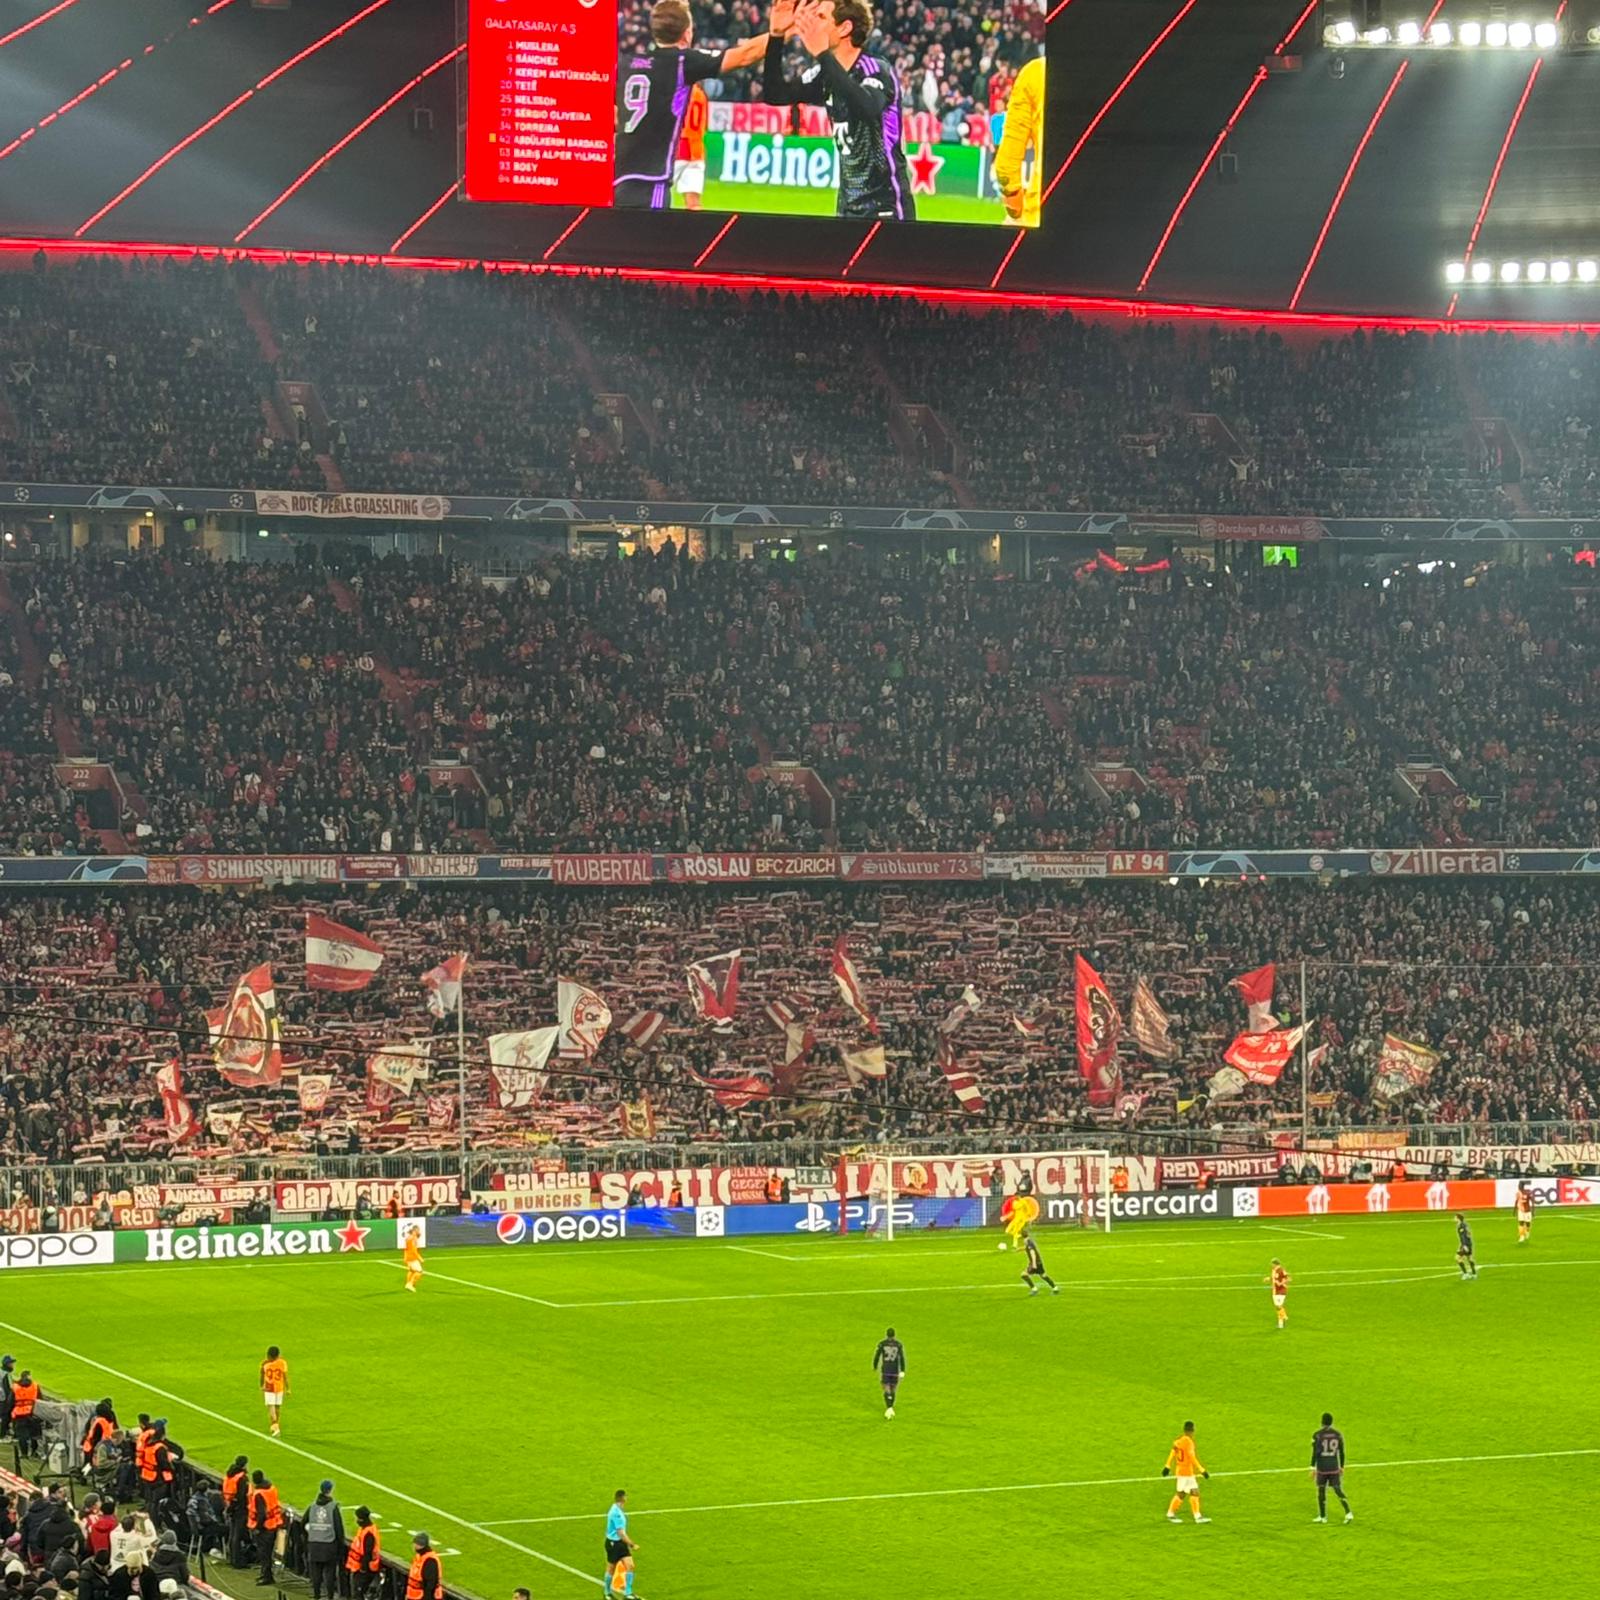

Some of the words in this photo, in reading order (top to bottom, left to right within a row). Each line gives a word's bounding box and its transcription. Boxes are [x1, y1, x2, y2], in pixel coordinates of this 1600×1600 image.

[485, 18, 558, 32] GALATASARAY
[515, 41, 560, 52] MUSLERA
[515, 68, 547, 79] KEREM
[624, 74, 651, 133] 9
[550, 111, 591, 121] OLIVEIRA
[514, 122, 560, 133] TORREIRA
[542, 150, 572, 160] ALPER
[574, 151, 607, 162] YILMAZ
[513, 175, 559, 186] BAKAMBU
[291, 495, 319, 513] ROTE
[320, 496, 352, 514] PERLE
[73, 769, 90, 779] 222
[207, 858, 337, 879] SCHLOSSPANTHER
[553, 858, 651, 881] TAUBERTAL
[756, 858, 783, 873] BFC
[862, 858, 940, 875] Südkurve
[1112, 854, 1135, 871] AF
[1141, 854, 1165, 871] 94
[1393, 851, 1504, 875] Zillertal
[1047, 1189, 1218, 1219] mastercard
[121, 1208, 154, 1226] RED
[533, 1209, 626, 1243] pepsi
[0, 1233, 98, 1266] ppo
[145, 1224, 333, 1262] Heineken
[1321, 1438, 1339, 1456] 19
